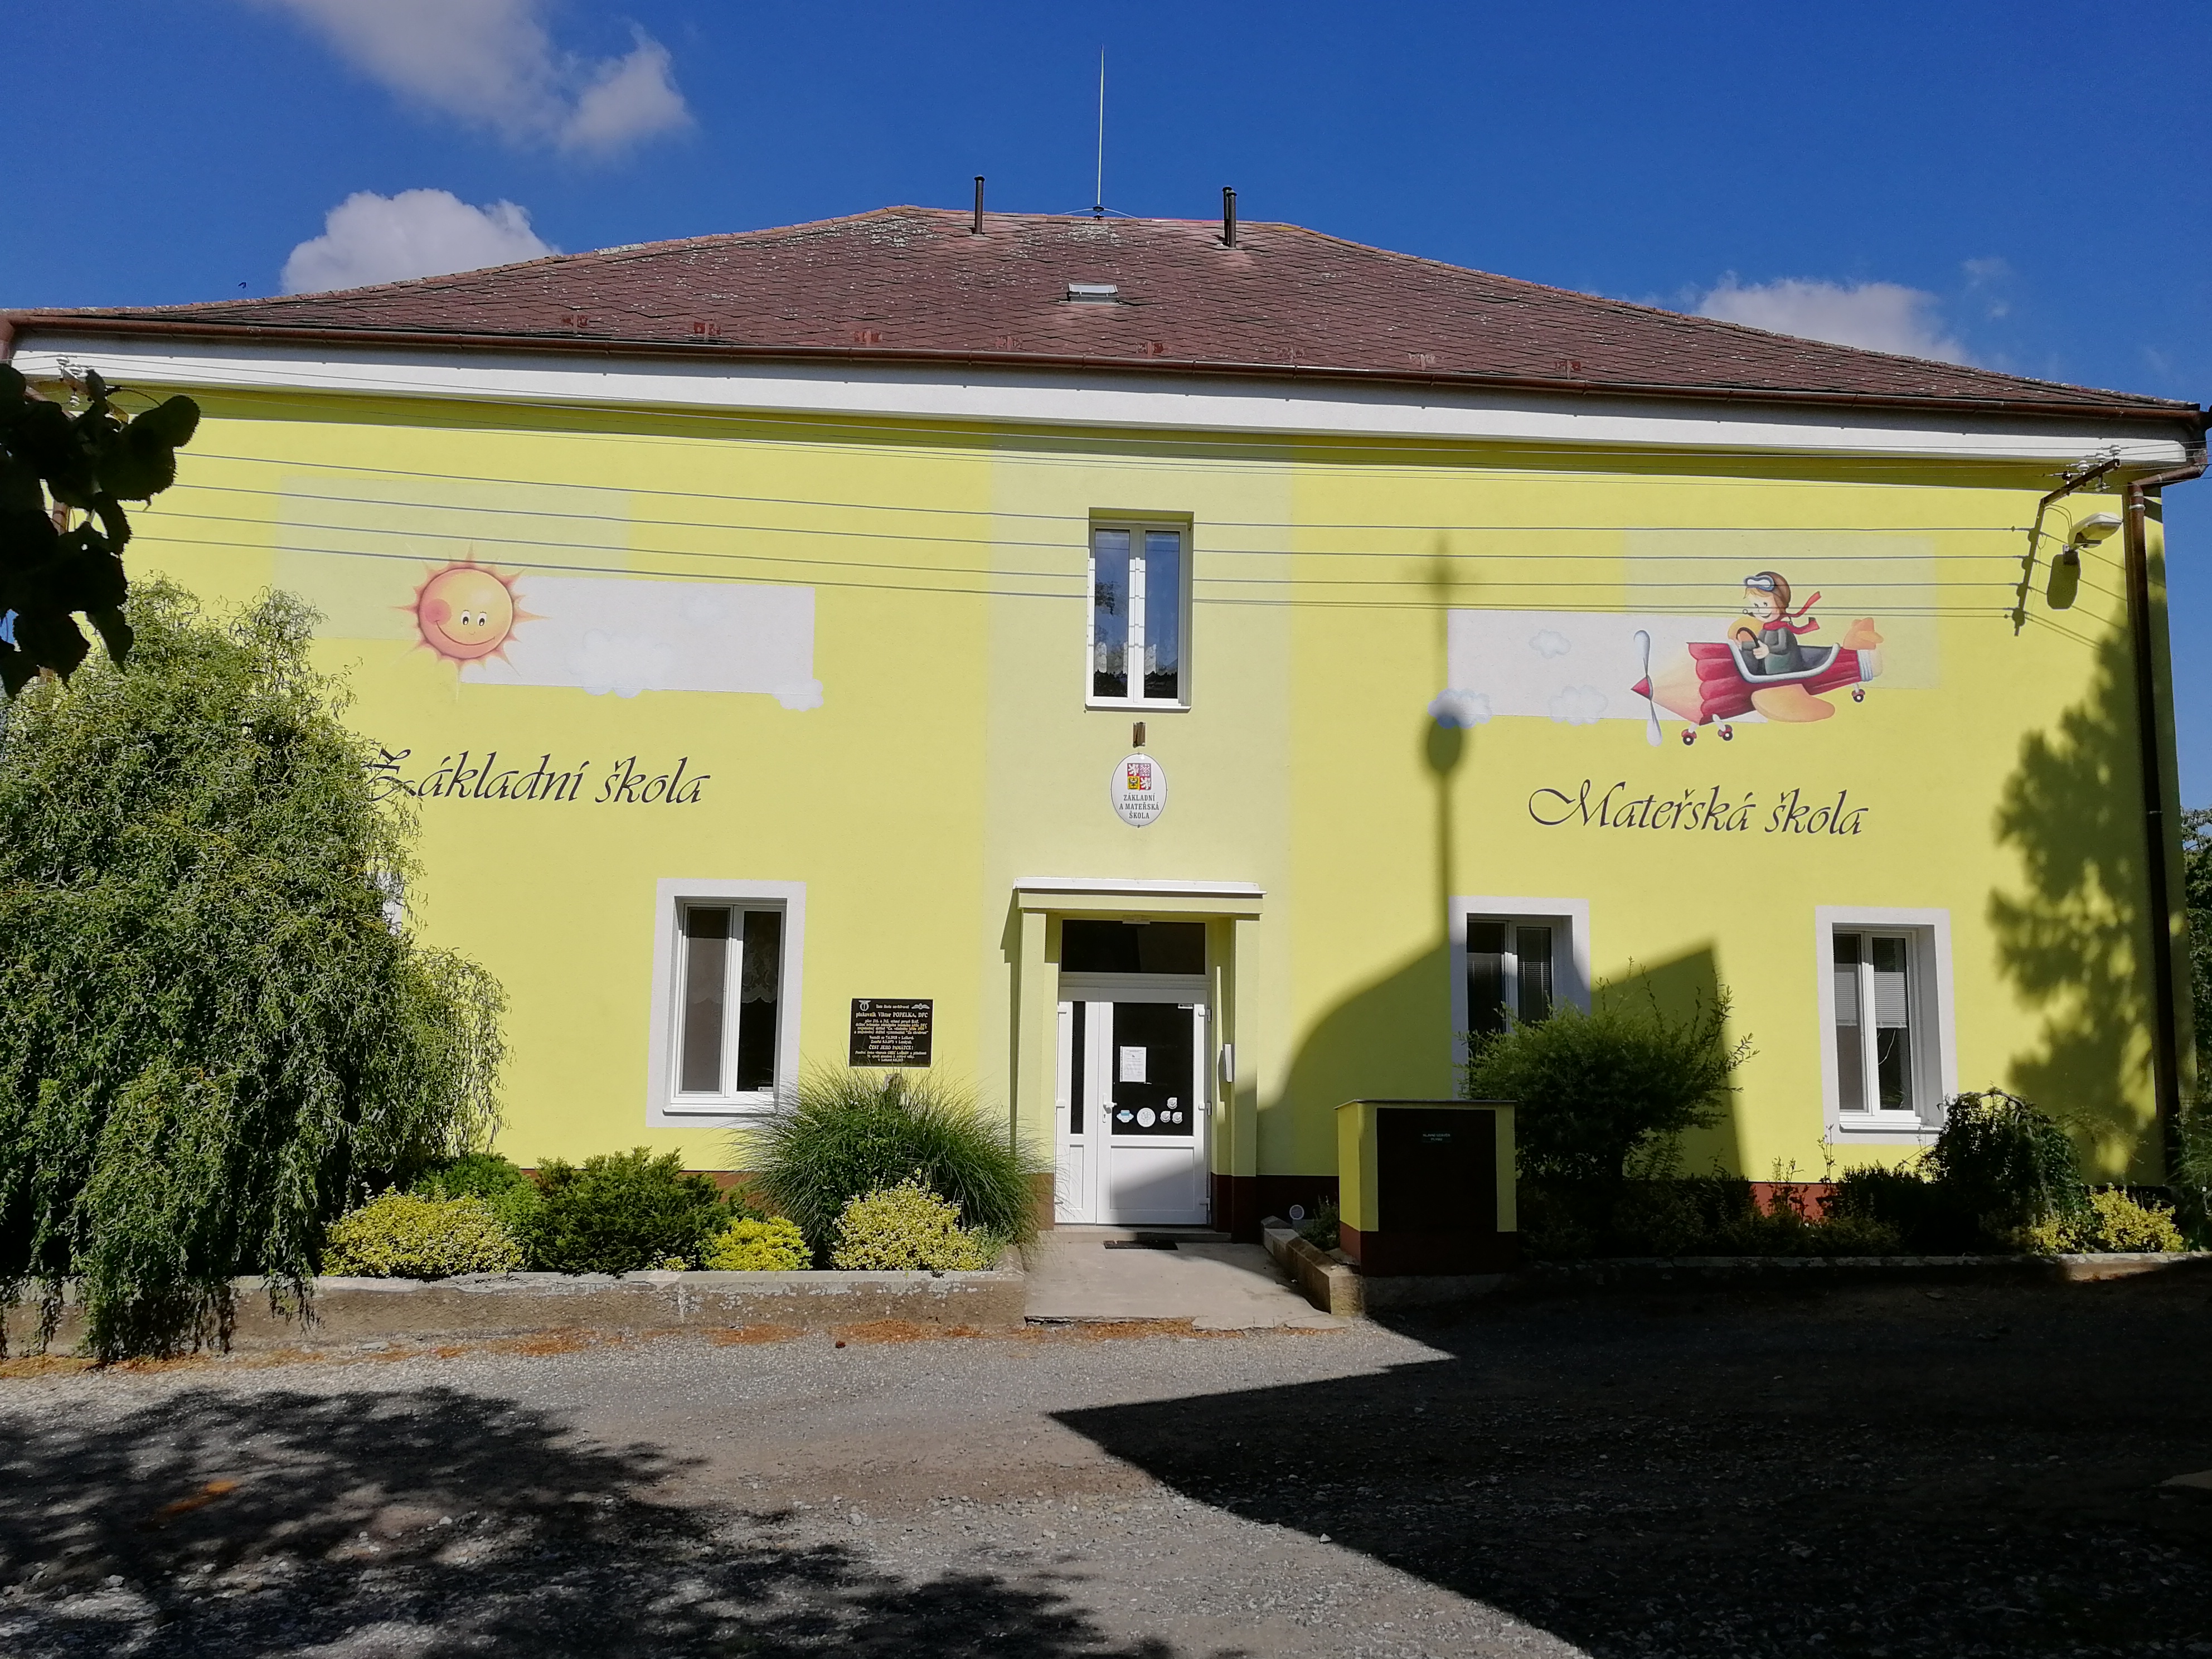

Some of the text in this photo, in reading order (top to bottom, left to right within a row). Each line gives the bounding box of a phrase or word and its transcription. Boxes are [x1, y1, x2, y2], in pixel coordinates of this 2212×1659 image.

[595, 755, 711, 804] škola
[1123, 793, 1155, 801] ZÁKLADNÍ
[1125, 802, 1159, 810] MATEŘSKÁ
[1529, 779, 1869, 835] Mateřská škola
[1129, 811, 1149, 819] ŠKOLA
